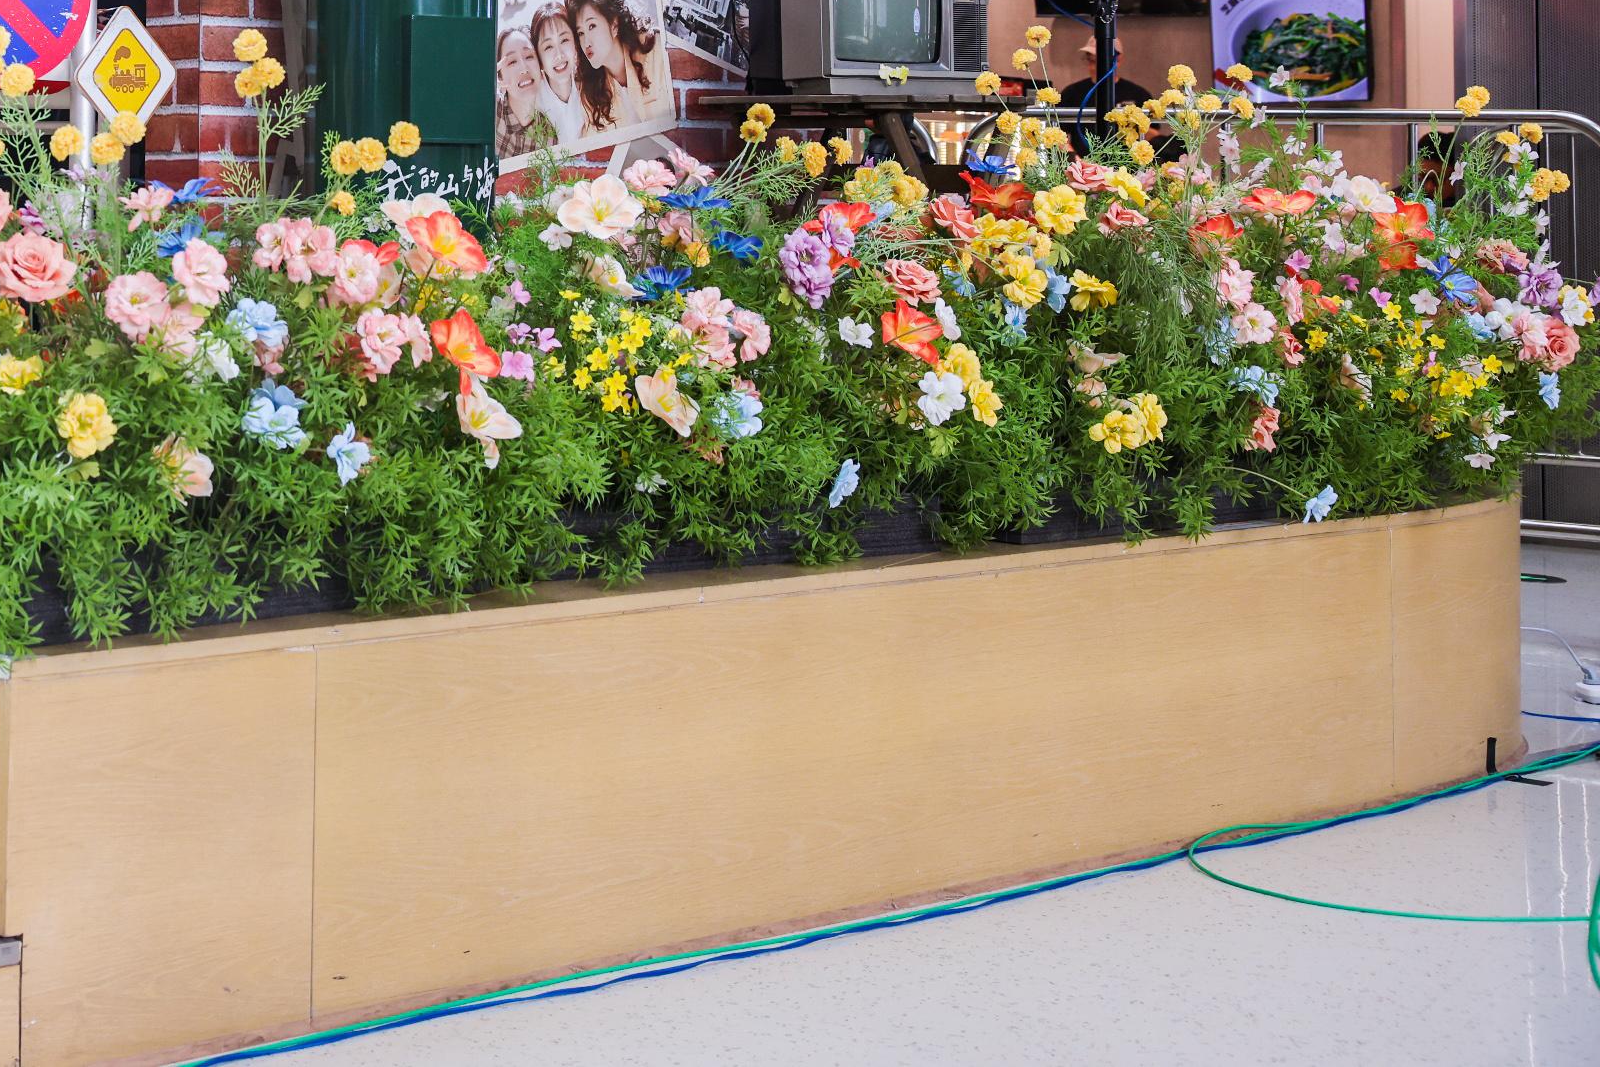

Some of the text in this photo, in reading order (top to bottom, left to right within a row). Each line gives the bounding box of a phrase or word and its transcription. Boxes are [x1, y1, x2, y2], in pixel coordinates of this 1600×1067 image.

[375, 156, 495, 221] 我的山与海
